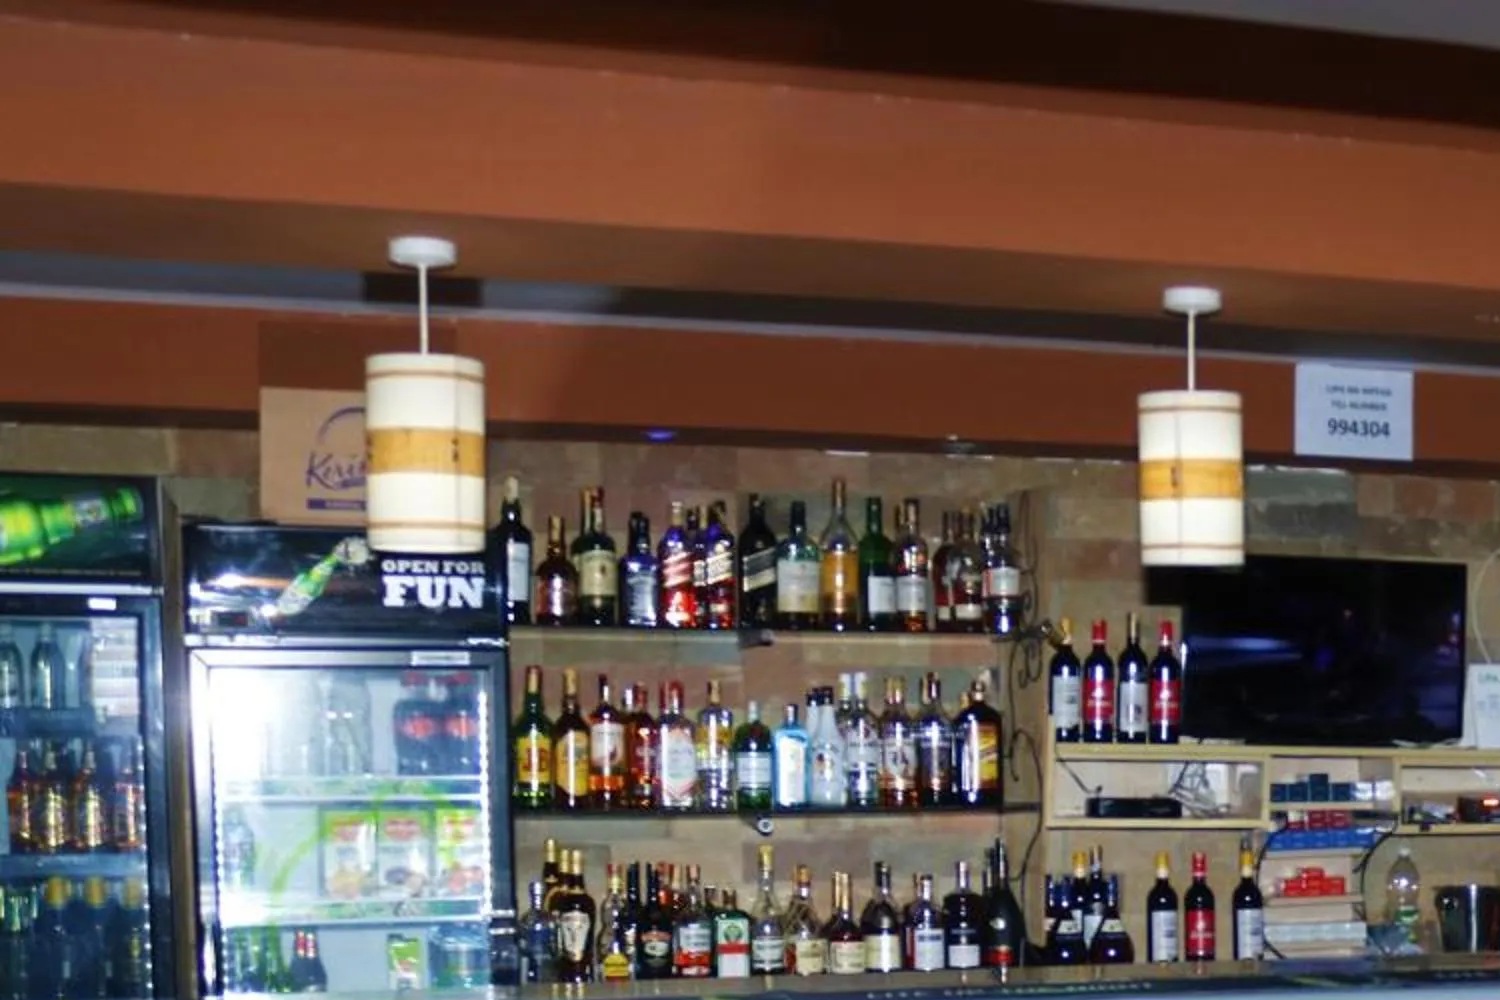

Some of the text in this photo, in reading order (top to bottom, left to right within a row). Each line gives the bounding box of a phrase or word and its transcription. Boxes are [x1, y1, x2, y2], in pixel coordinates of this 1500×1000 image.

[1327, 417, 1391, 438] 994304
[382, 560, 485, 574] OPEN FOR
[382, 575, 485, 608] FUN
